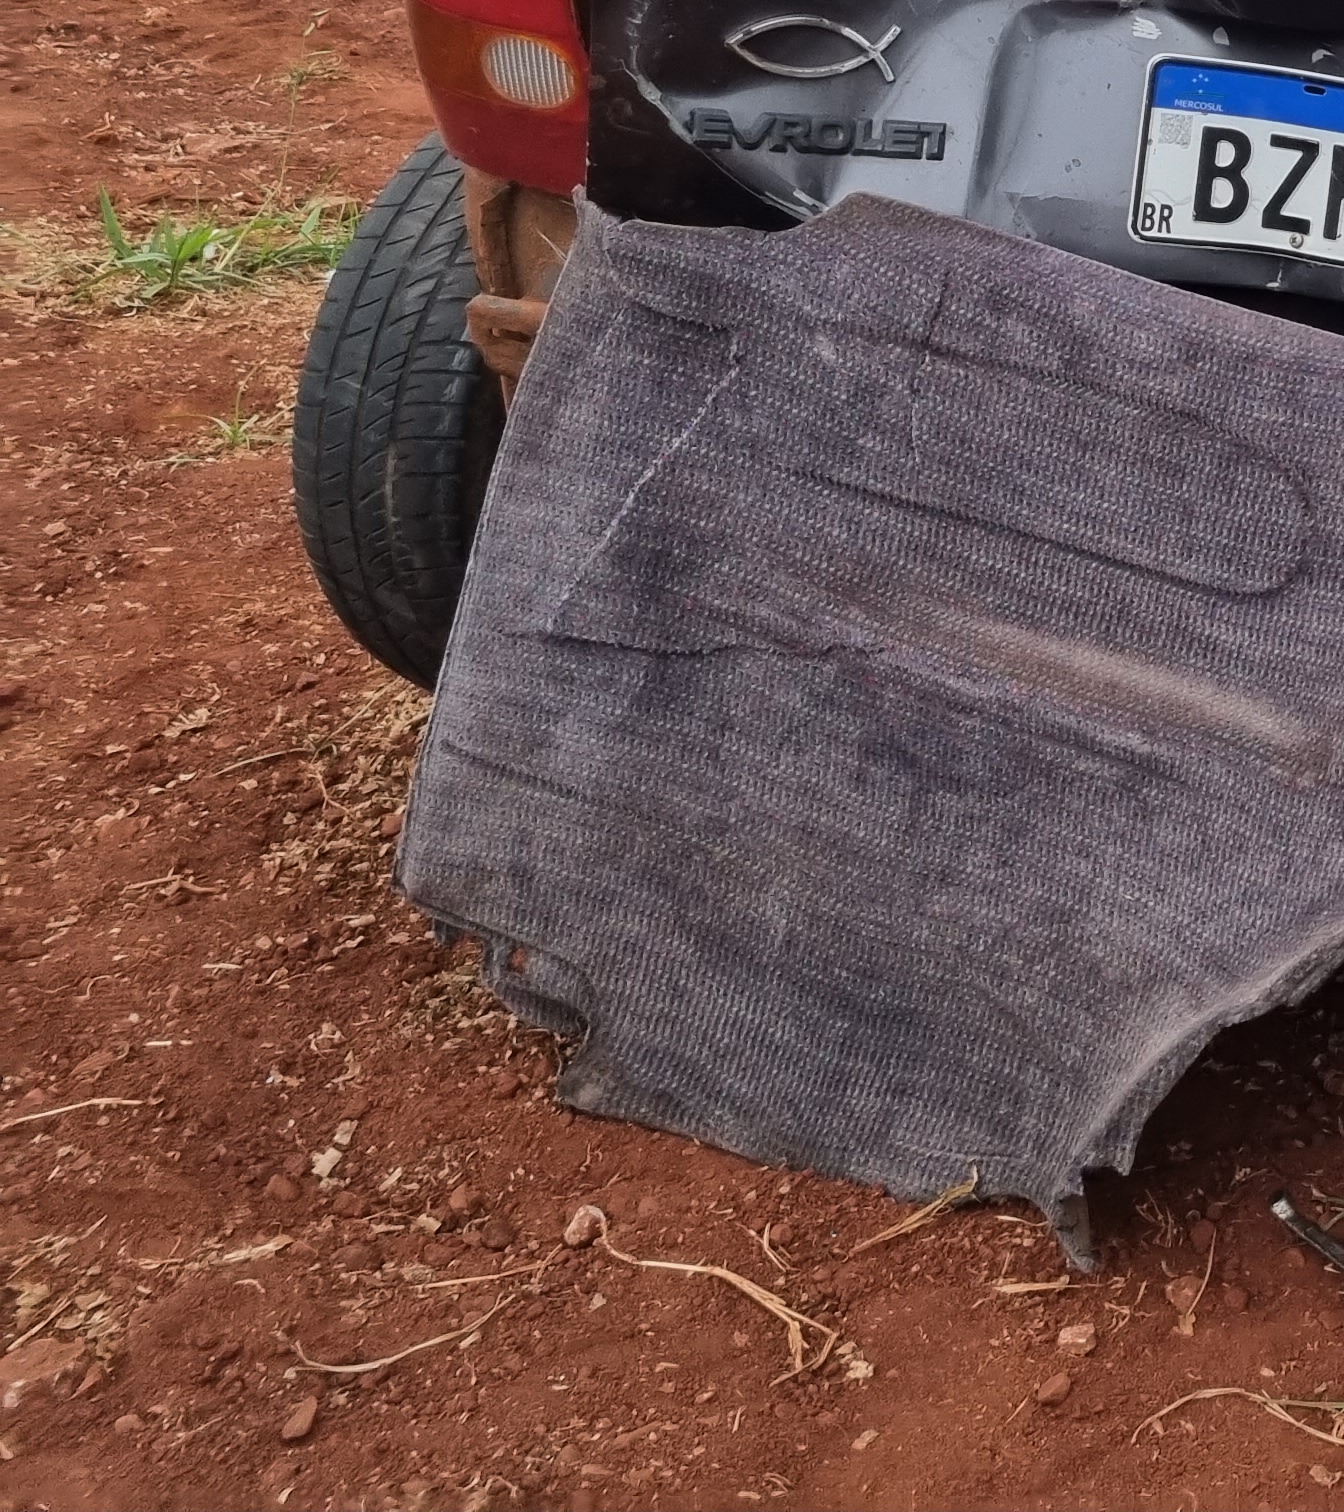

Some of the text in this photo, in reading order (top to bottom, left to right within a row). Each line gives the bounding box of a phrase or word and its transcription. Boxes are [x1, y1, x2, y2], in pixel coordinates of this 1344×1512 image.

[1174, 98, 1224, 112] MERCOSUL
[686, 107, 947, 161] EVROLET
[1140, 202, 1173, 235] BR
